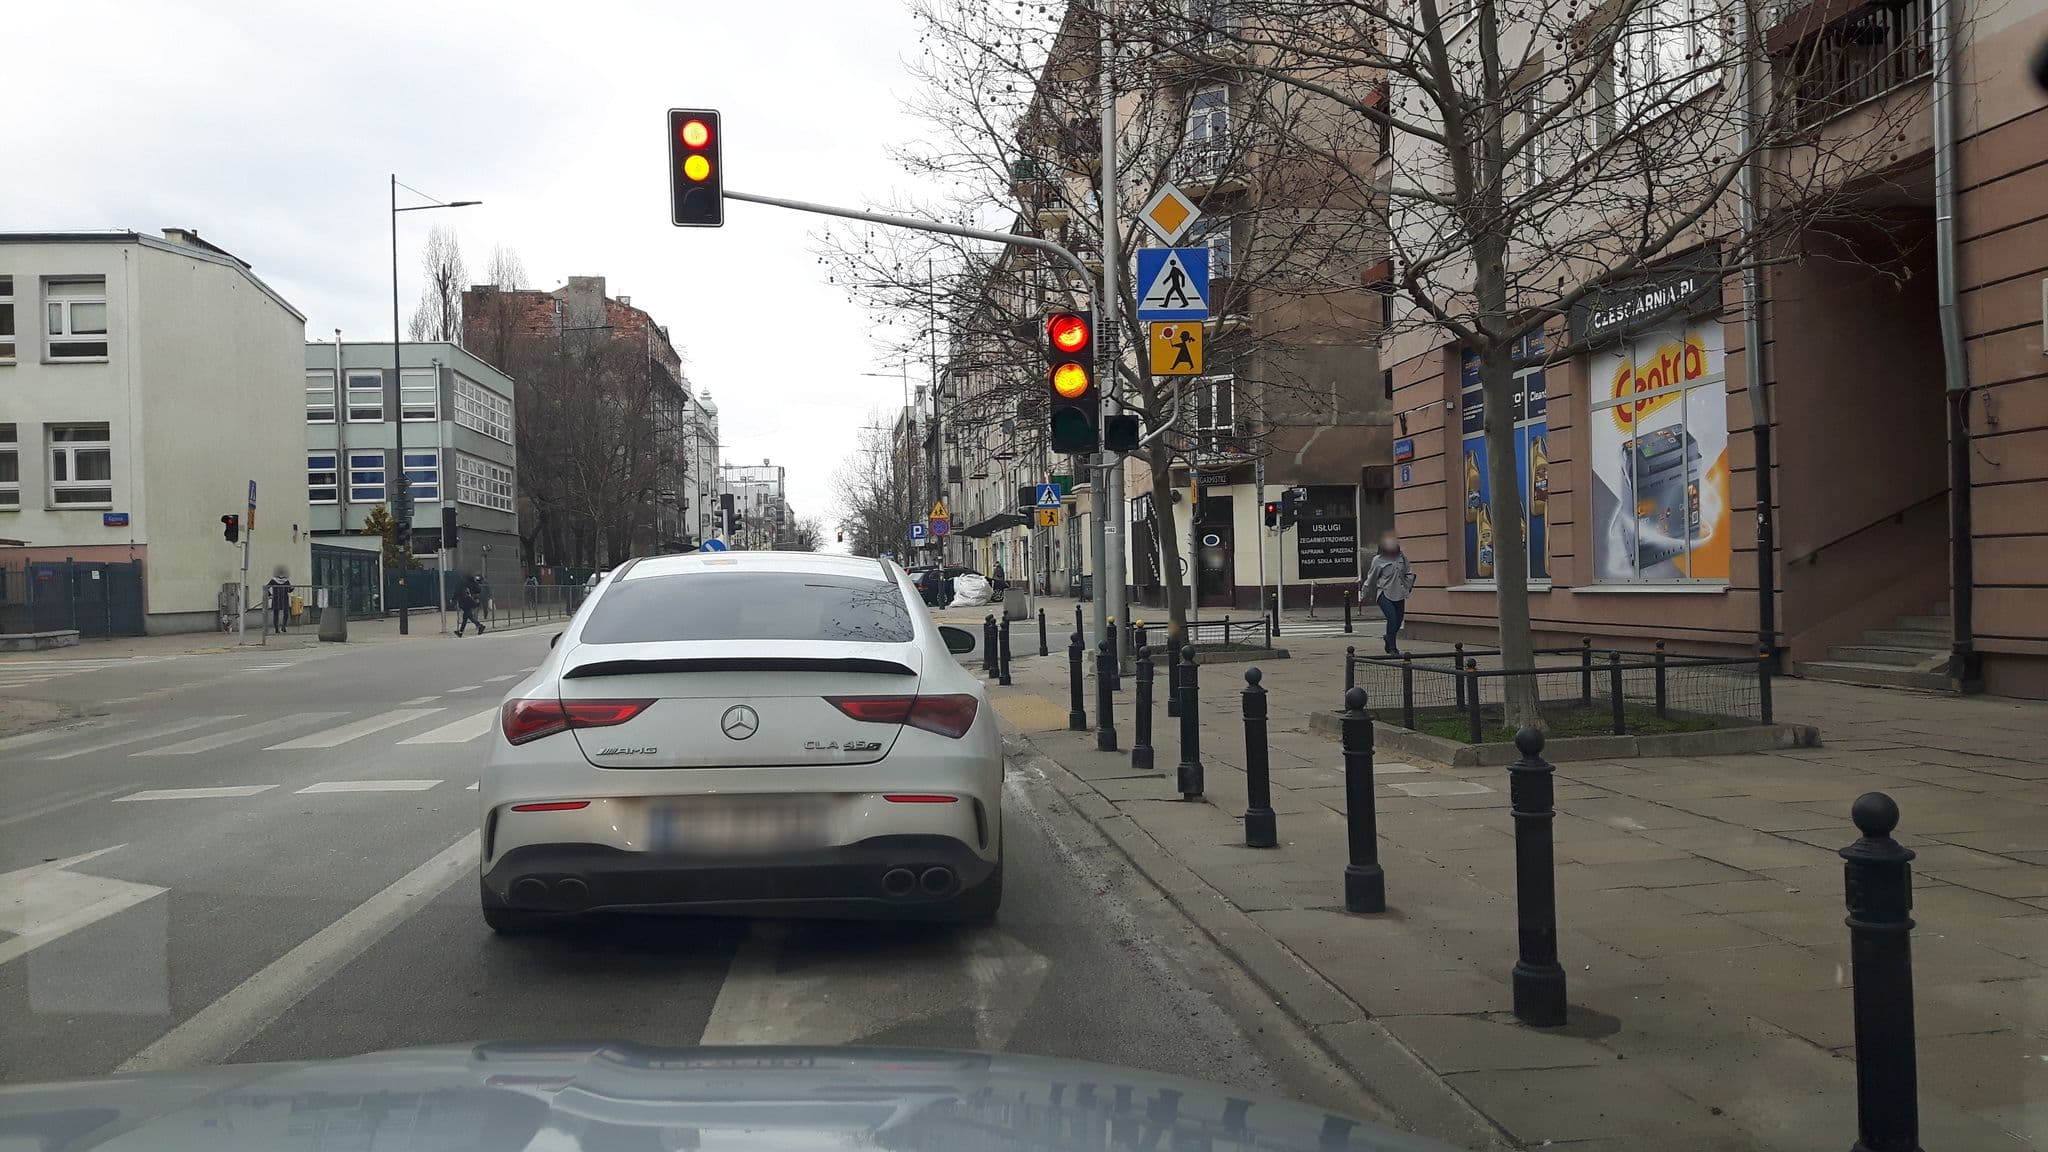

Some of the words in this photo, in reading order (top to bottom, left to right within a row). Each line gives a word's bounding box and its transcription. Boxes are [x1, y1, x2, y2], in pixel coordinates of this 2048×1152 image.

[1616, 344, 1702, 423] Centra
[912, 525, 923, 538] P
[1312, 523, 1341, 532] USŁUGI
[1299, 535, 1354, 544] ZEGARMISTRZOWSKIE
[804, 741, 840, 750] CLA
